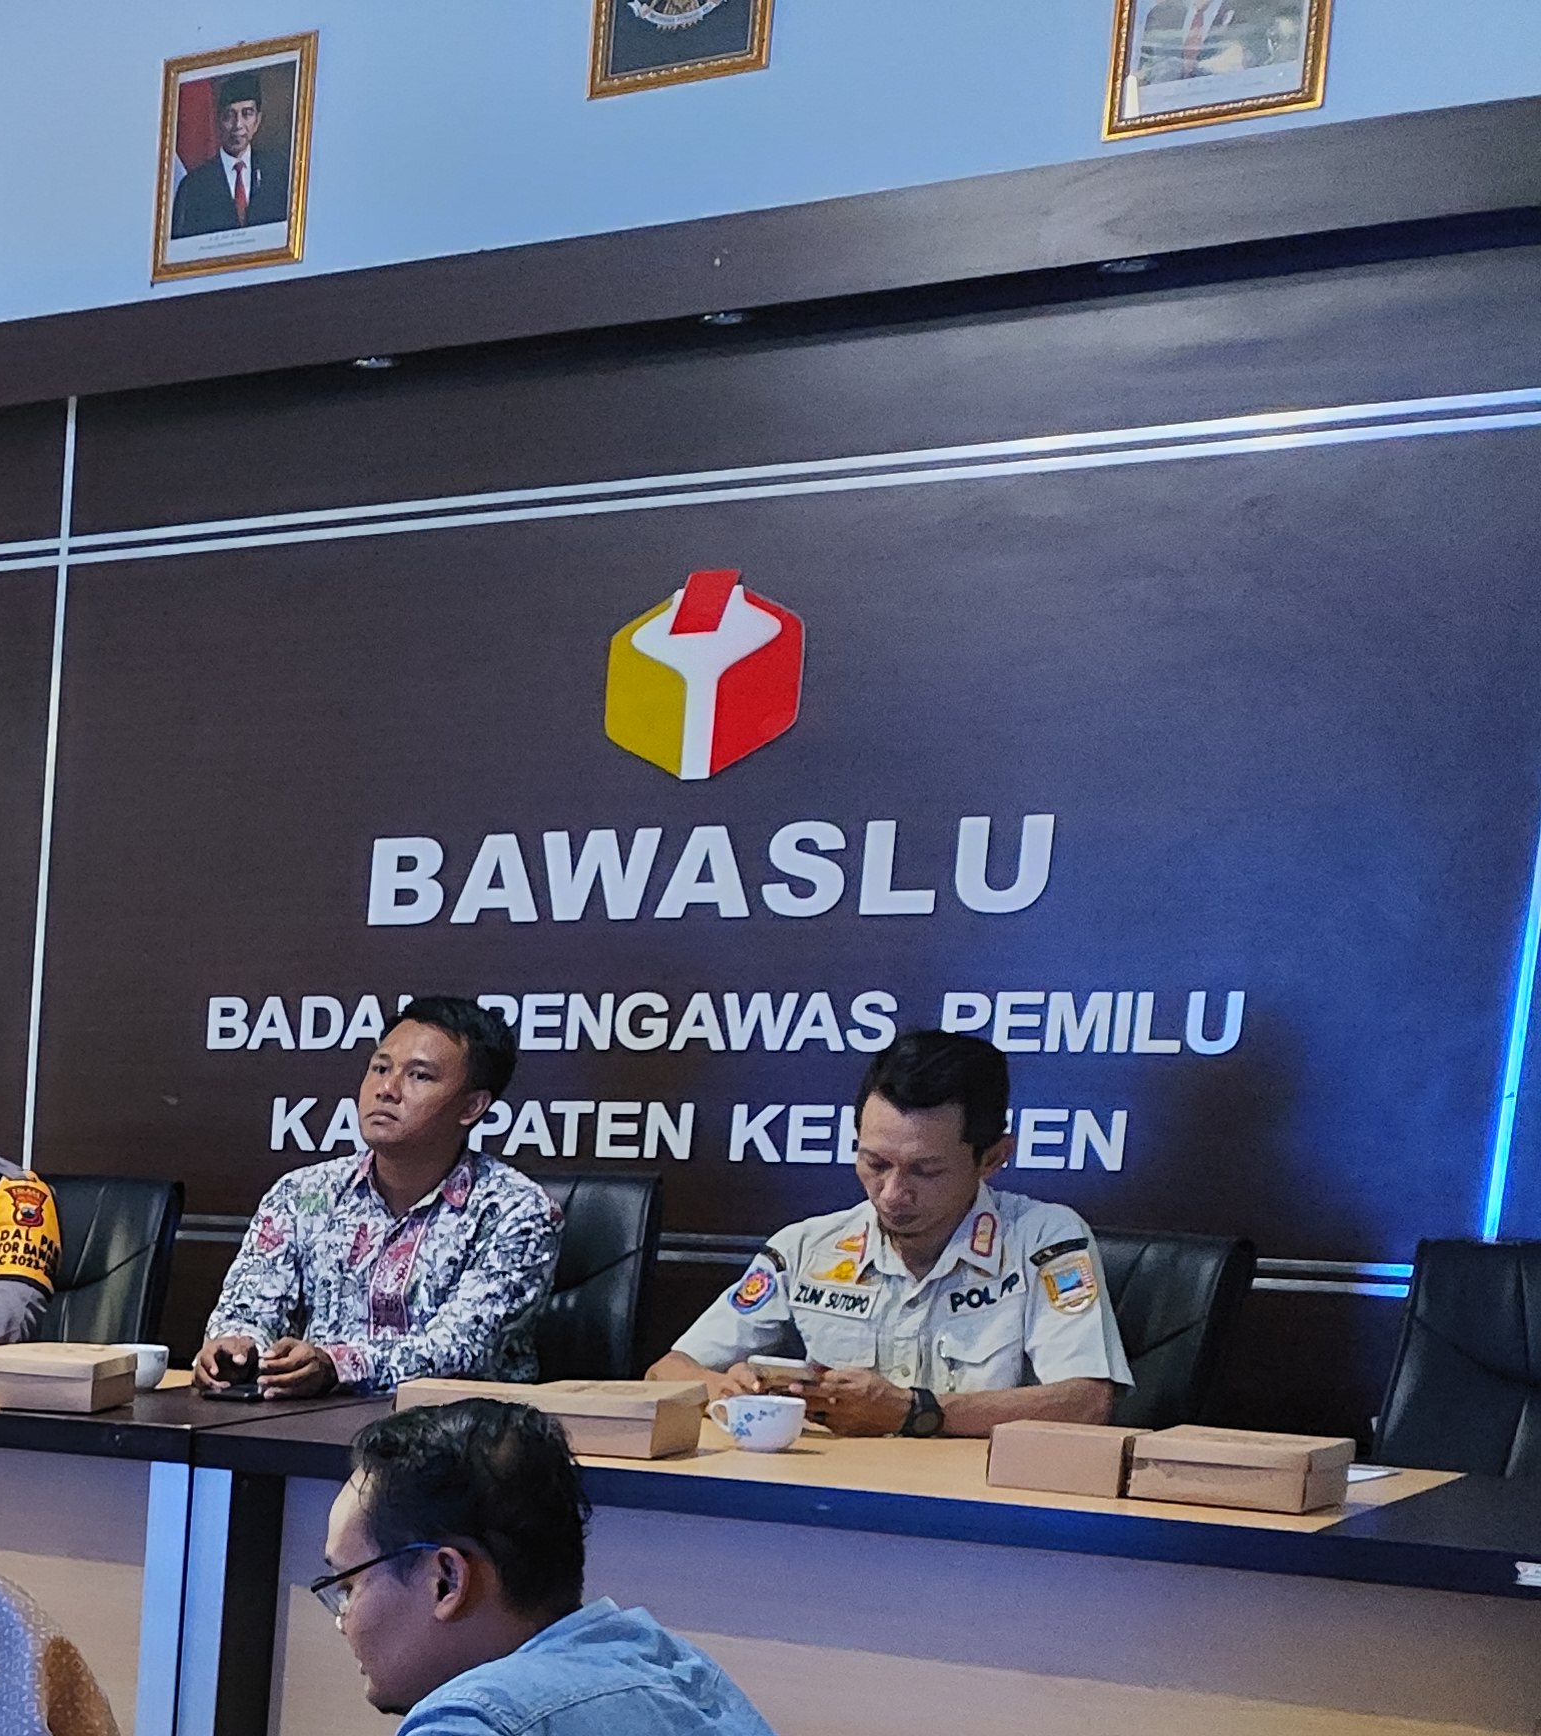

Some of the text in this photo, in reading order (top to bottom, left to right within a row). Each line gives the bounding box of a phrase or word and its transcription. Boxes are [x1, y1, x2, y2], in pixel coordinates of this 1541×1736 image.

[366, 813, 1057, 927] BAWASLU
[206, 996, 414, 1050] BADA
[270, 1097, 1128, 1171] KAPATEN KEEN
[949, 1285, 997, 1313] POL
